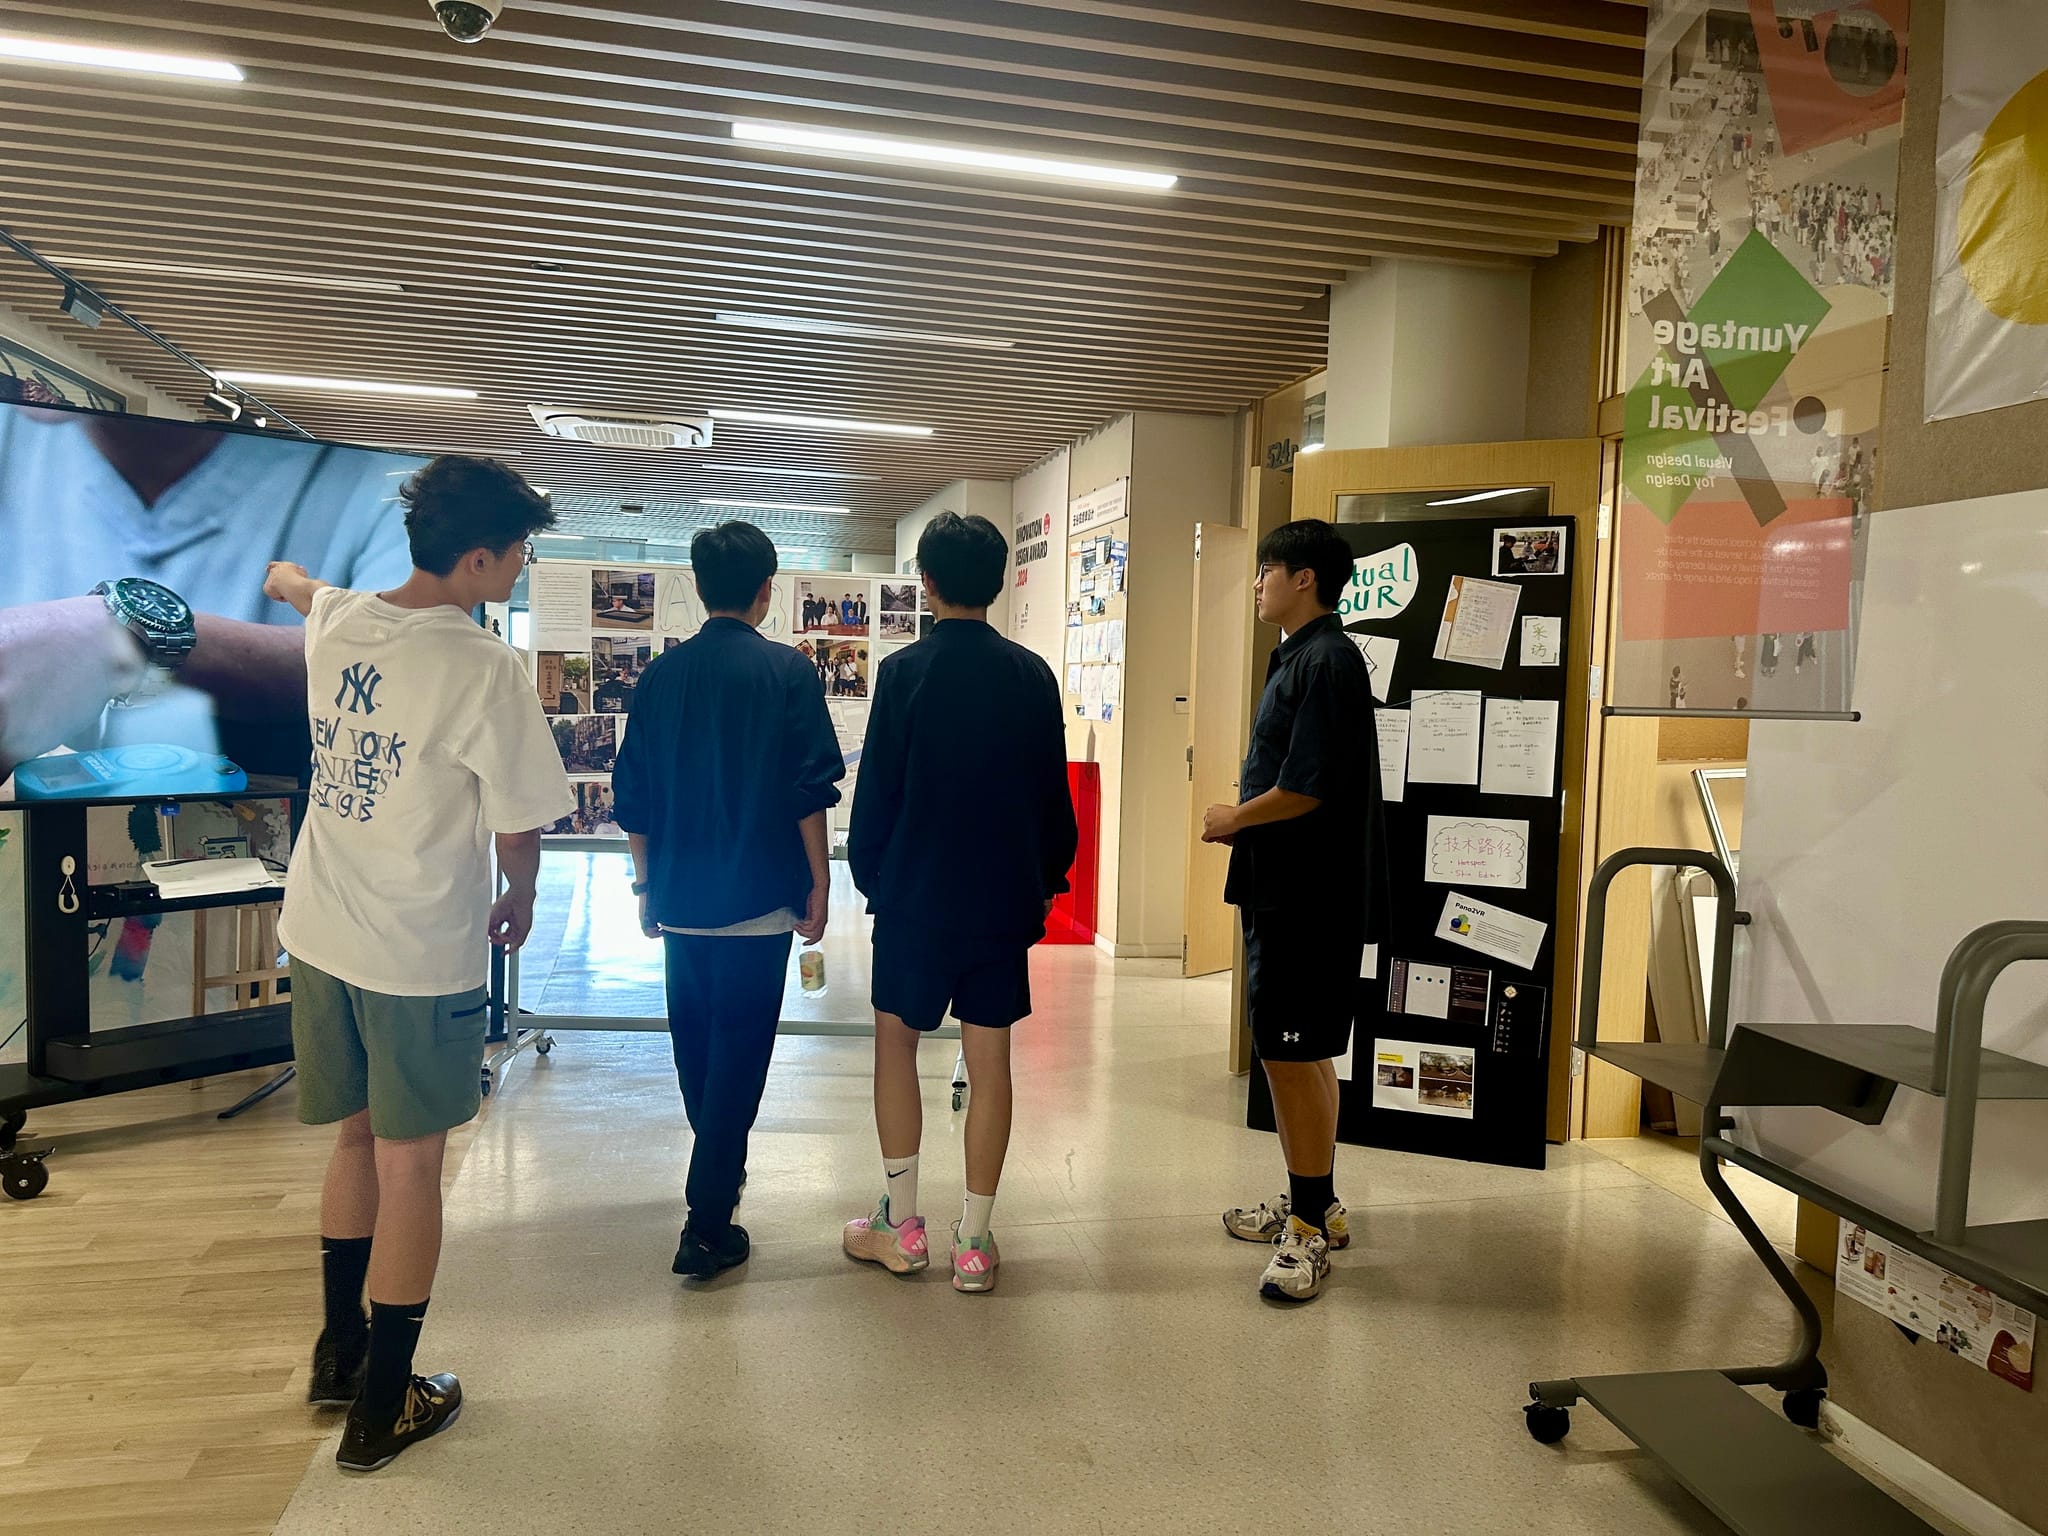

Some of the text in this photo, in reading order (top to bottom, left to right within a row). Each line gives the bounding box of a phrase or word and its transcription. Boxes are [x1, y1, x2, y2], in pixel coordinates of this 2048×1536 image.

[1029, 540, 1048, 562] AWARD
[335, 662, 382, 715] NY
[312, 750, 392, 795] ANKEES
[348, 728, 406, 777] YORK
[1456, 902, 1485, 917] Pano2VR
